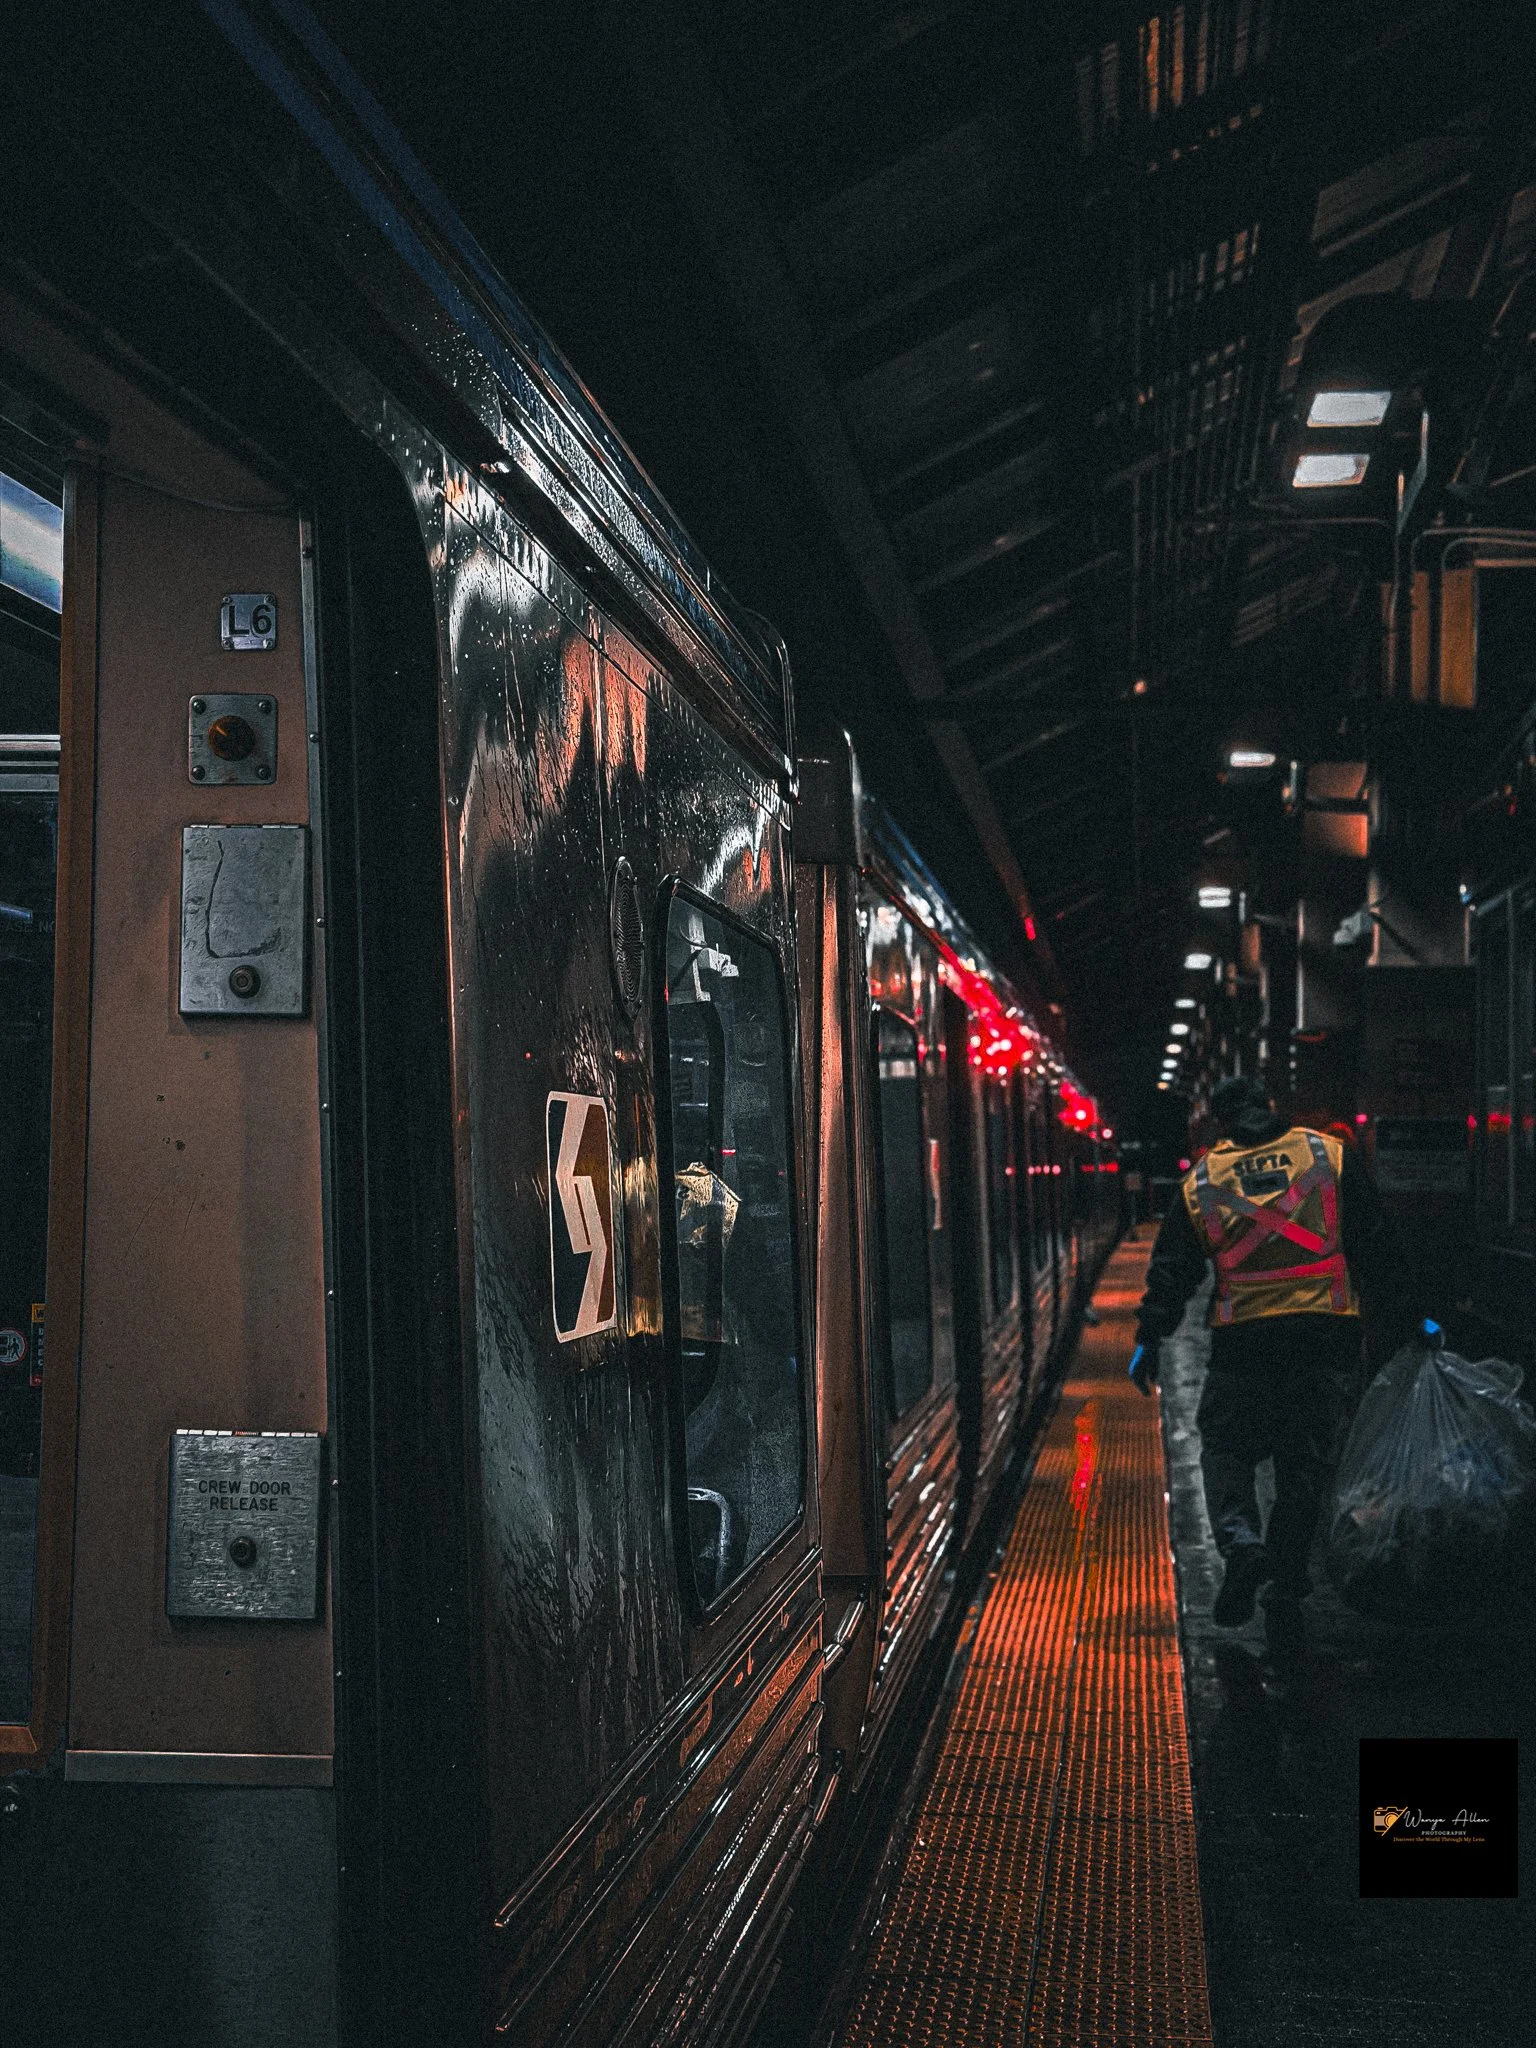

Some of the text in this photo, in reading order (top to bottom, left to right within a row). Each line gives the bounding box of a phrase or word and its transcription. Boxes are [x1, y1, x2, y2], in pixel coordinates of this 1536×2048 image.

[229, 604, 272, 634] L6
[1232, 1153, 1293, 1177] SEPTA
[199, 1480, 291, 1495] CREW DOOR
[209, 1497, 279, 1511] RELEASE
